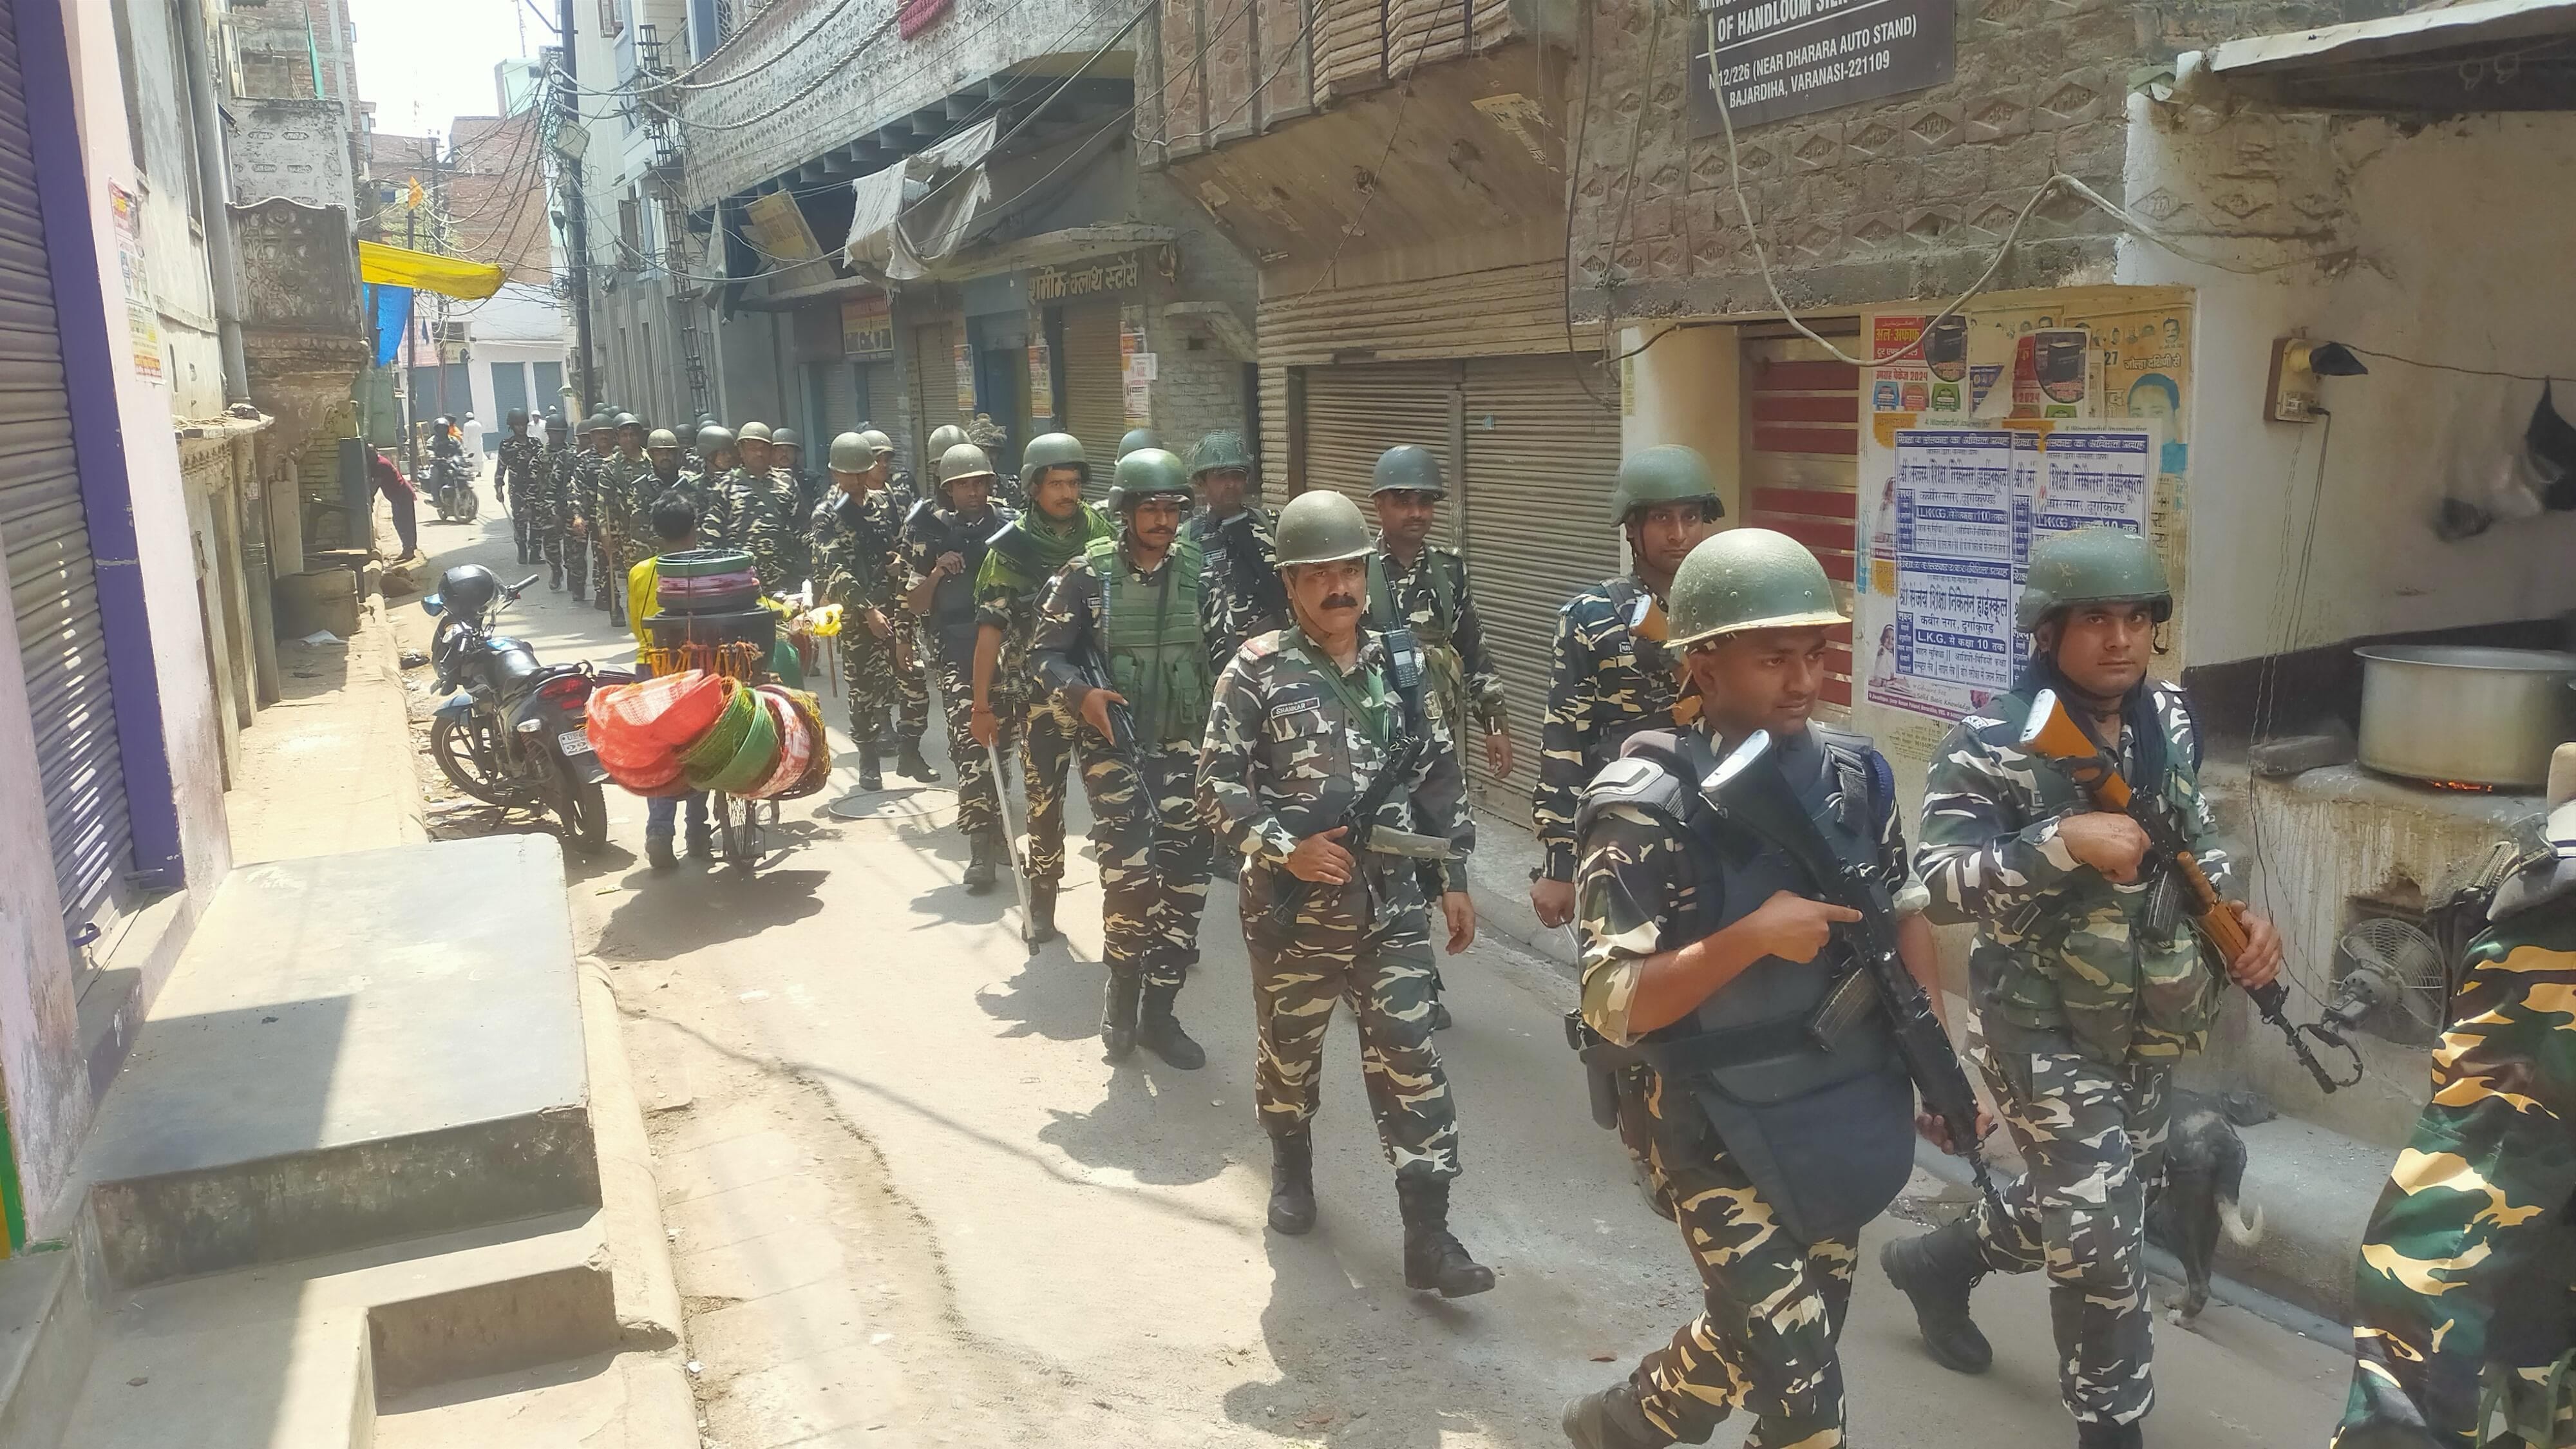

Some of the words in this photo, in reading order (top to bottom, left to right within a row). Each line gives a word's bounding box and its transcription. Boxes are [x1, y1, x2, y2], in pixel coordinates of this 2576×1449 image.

[1717, 15, 1734, 43] OF
[1737, 0, 1812, 37] HANDLOOM
[1752, 56, 1784, 82] (NEAR
[1786, 41, 1837, 70] DHARARA
[1839, 30, 1870, 52] AUTO
[1873, 14, 1917, 44] STAND)
[1729, 80, 1788, 109] BAJARDIHA,
[1790, 50, 1890, 93] VARANASI-221109
[1910, 371, 1928, 381] 2024
[2172, 353, 2182, 368] से
[1930, 583, 1947, 609] शिक्षा
[1948, 586, 1975, 612] निकेतन
[1976, 589, 2008, 625] हाईस्कूल
[1941, 617, 1960, 631] नगर,
[1962, 617, 1994, 635] दुर्गाकुण्ड
[1917, 632, 1946, 644] L.K.G.
[1949, 636, 1955, 645] से
[1957, 639, 1974, 648] कक्षा
[1977, 639, 1988, 650] 10
[1992, 643, 2005, 652] तक
